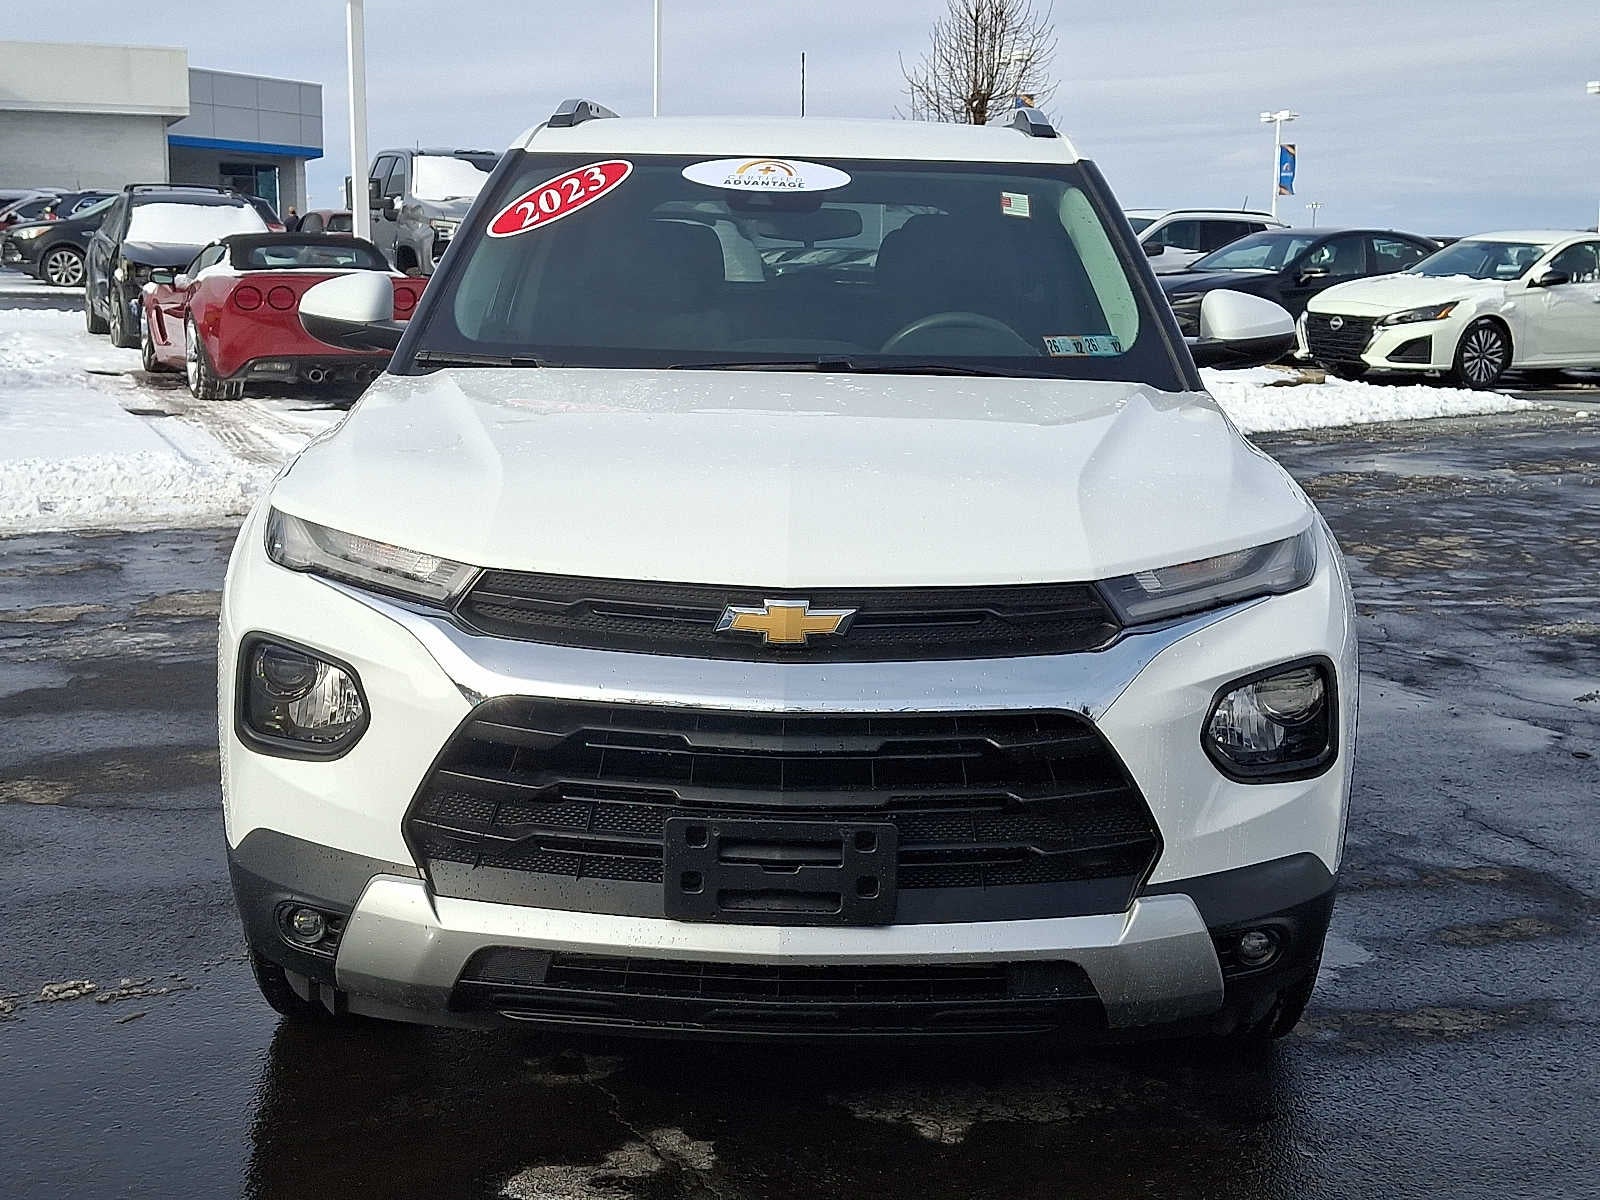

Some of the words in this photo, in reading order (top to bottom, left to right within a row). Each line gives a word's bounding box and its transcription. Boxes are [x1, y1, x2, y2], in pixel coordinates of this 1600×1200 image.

[723, 179, 806, 188] ADVANTAGE
[515, 166, 607, 228] 2023
[1046, 339, 1061, 353] 26
[1085, 338, 1098, 353] 26
